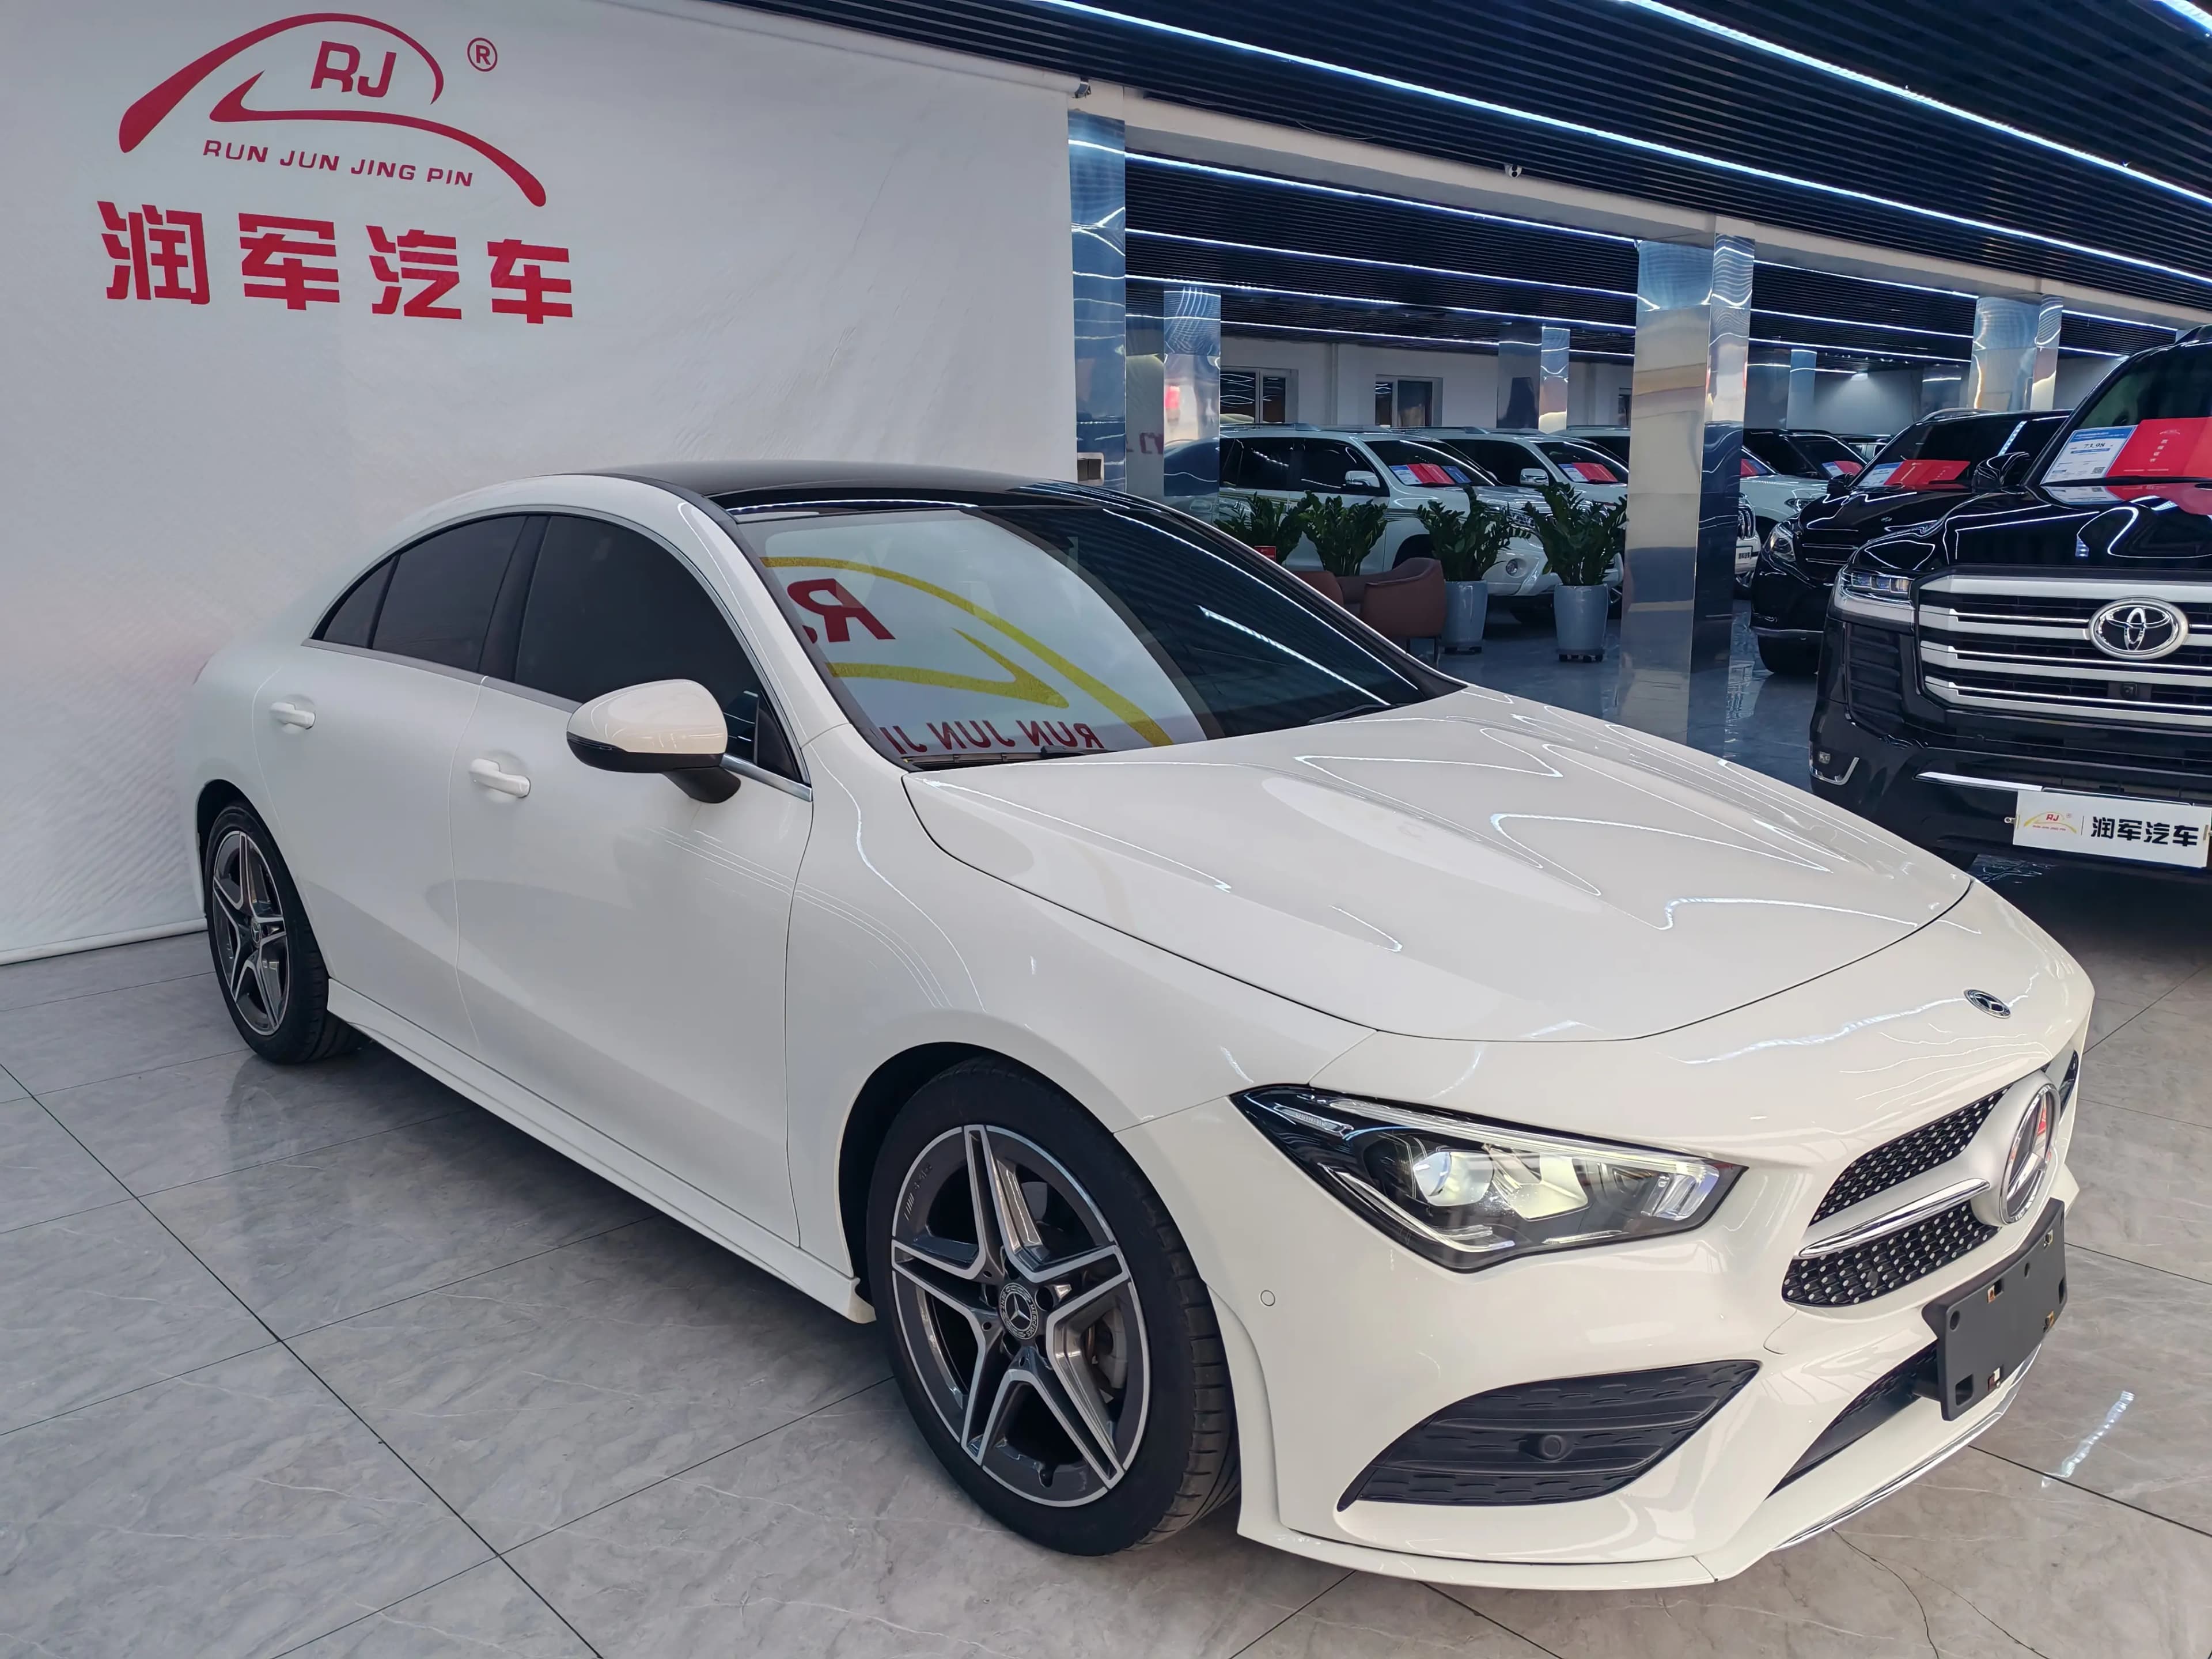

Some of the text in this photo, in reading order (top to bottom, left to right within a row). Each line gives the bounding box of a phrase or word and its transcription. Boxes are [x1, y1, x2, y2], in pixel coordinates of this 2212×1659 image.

[310, 41, 396, 98] RJ
[202, 140, 473, 187] RUN JUN JING PIN
[97, 200, 573, 324] 润军汽车
[2091, 816, 2199, 847] 润军汽车
